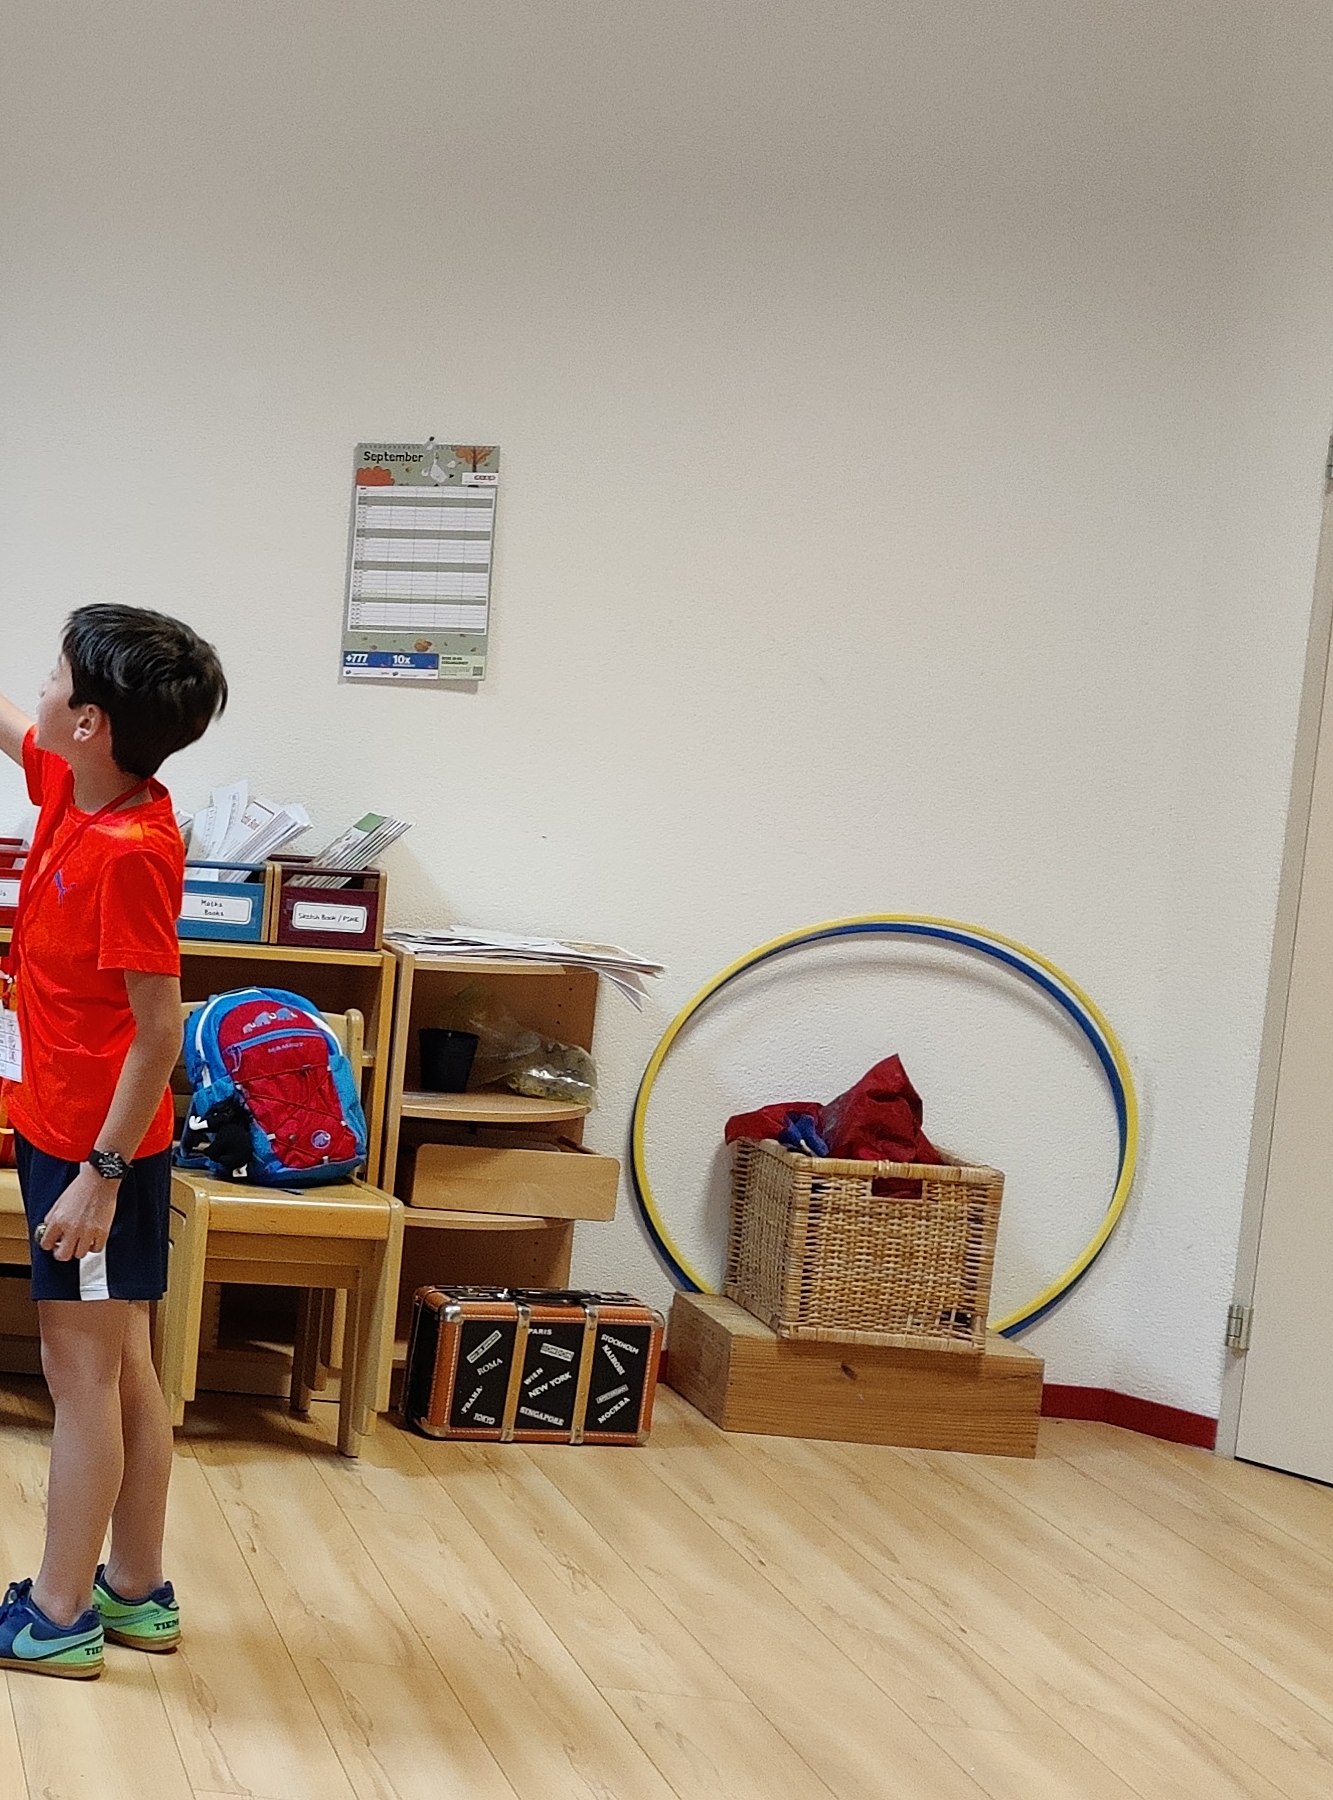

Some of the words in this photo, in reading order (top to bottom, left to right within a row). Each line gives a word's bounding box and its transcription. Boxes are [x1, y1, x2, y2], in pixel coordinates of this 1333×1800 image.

[363, 451, 424, 464] September
[393, 654, 411, 664] 10x
[528, 1328, 552, 1336] PARIS
[601, 1333, 640, 1355] STOCKHOLM
[476, 1357, 503, 1376] ROMA
[601, 1344, 625, 1375] NAIROBI
[523, 1367, 544, 1385] WIEN
[528, 1382, 549, 1398] NEW
[549, 1371, 573, 1387] YORK
[519, 1406, 565, 1426] SINGAPORE
